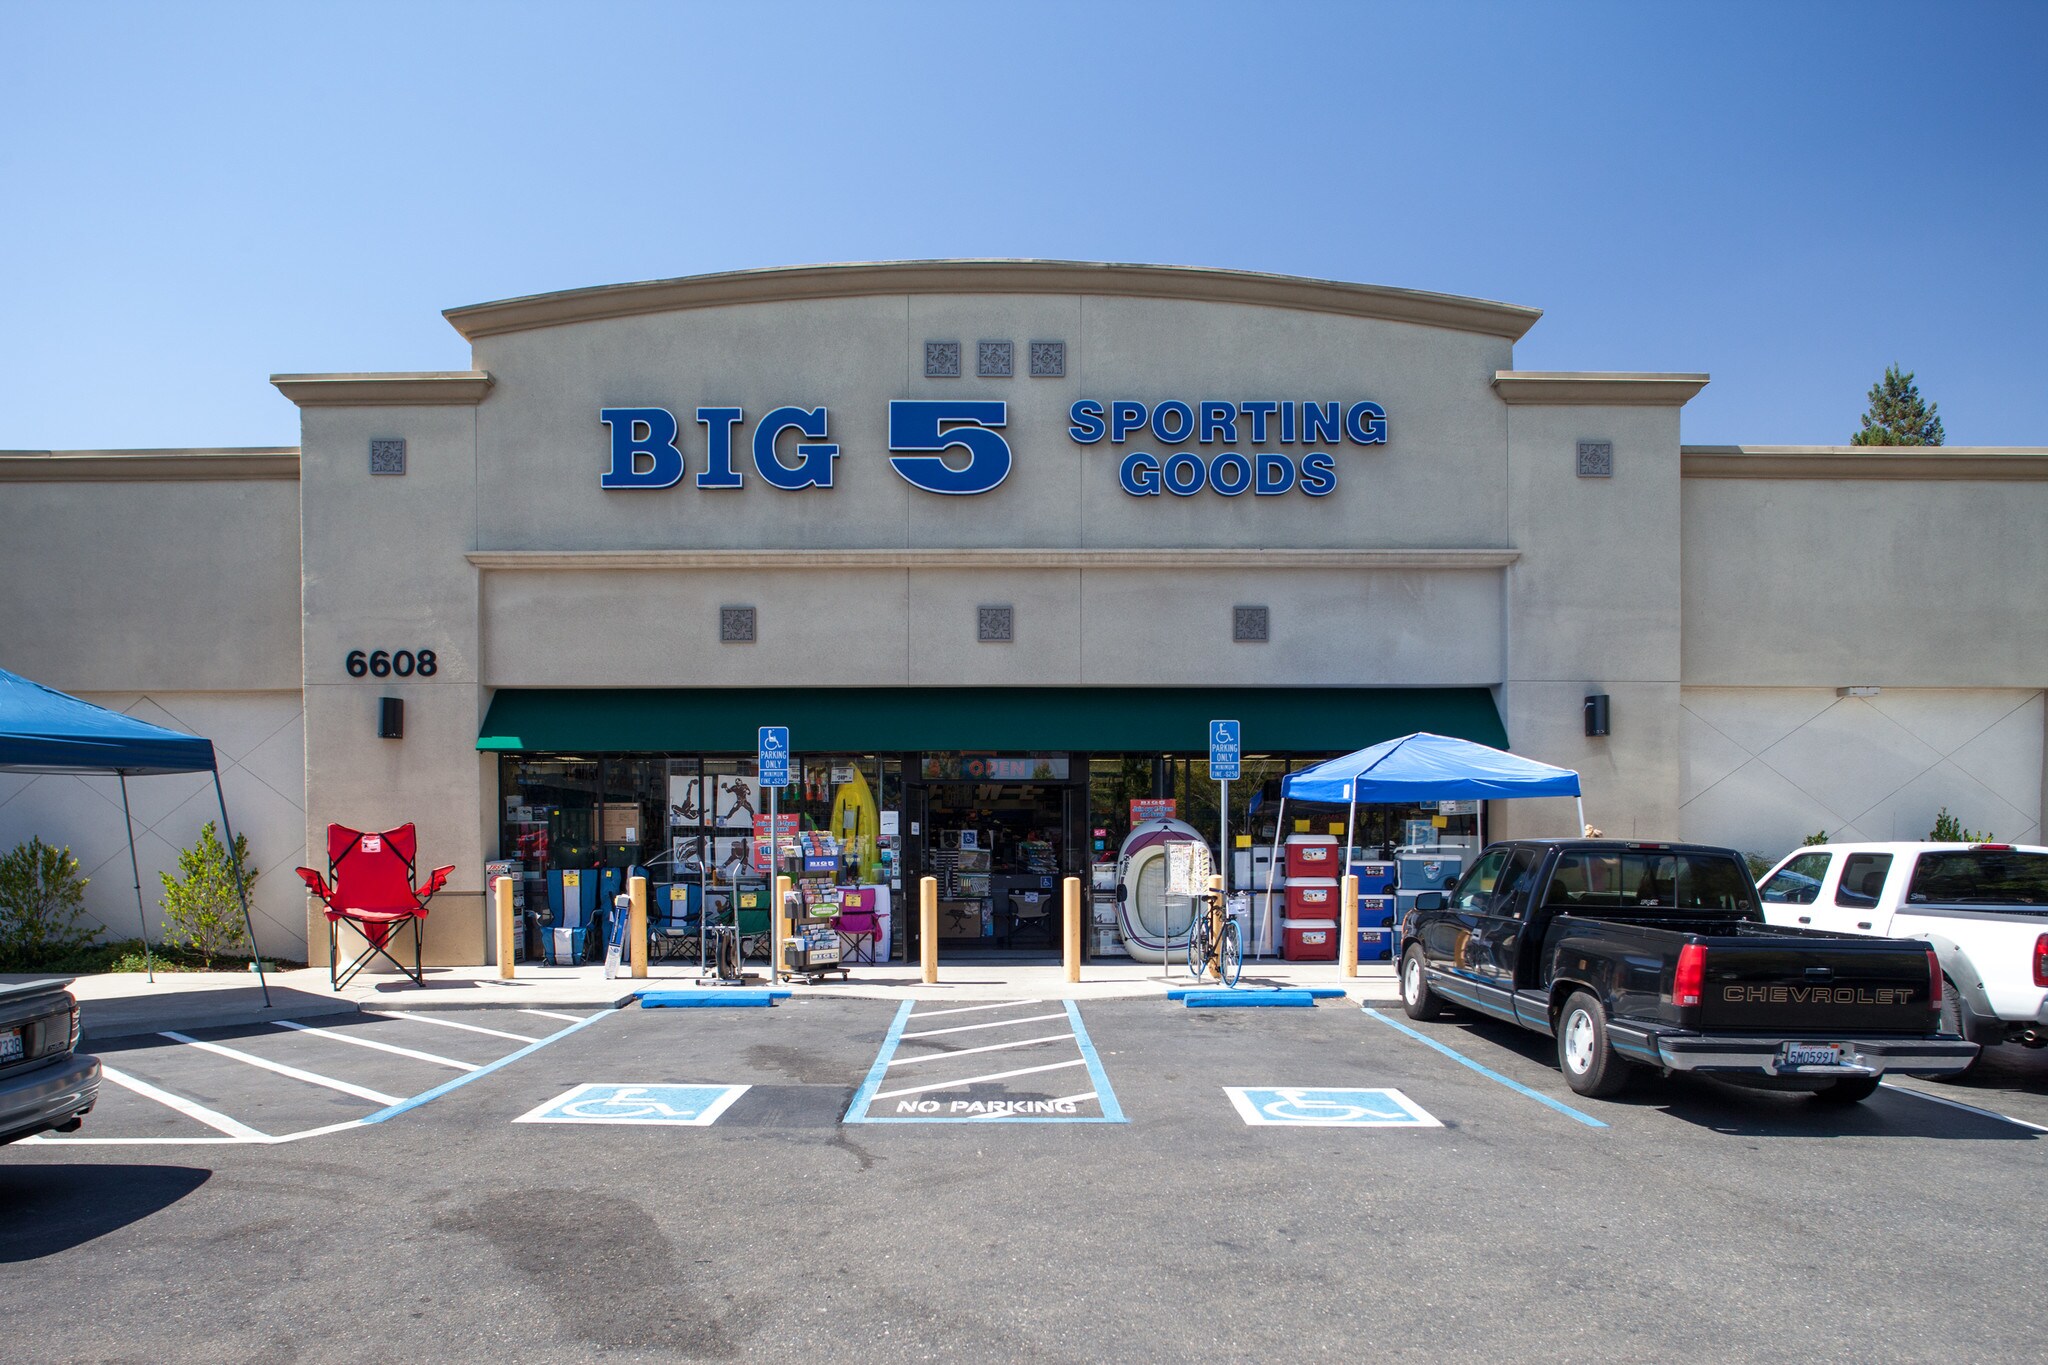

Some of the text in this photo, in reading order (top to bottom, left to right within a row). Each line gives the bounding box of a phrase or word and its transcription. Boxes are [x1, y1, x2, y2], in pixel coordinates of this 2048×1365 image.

[1068, 399, 1388, 445] SPORTING
[600, 400, 1013, 495] BIG 5
[1119, 452, 1338, 496] GOODS
[346, 649, 438, 678] 6608
[760, 751, 787, 759] PARKING
[1212, 744, 1238, 752] PARKING
[765, 761, 782, 769] ONLY
[1216, 753, 1233, 762] ONLY
[968, 760, 1026, 777] OPEN
[1723, 985, 1914, 1005] CHEVROLET
[1790, 1051, 1835, 1064] 5M05991
[896, 1100, 1077, 1113] NO PARKING
